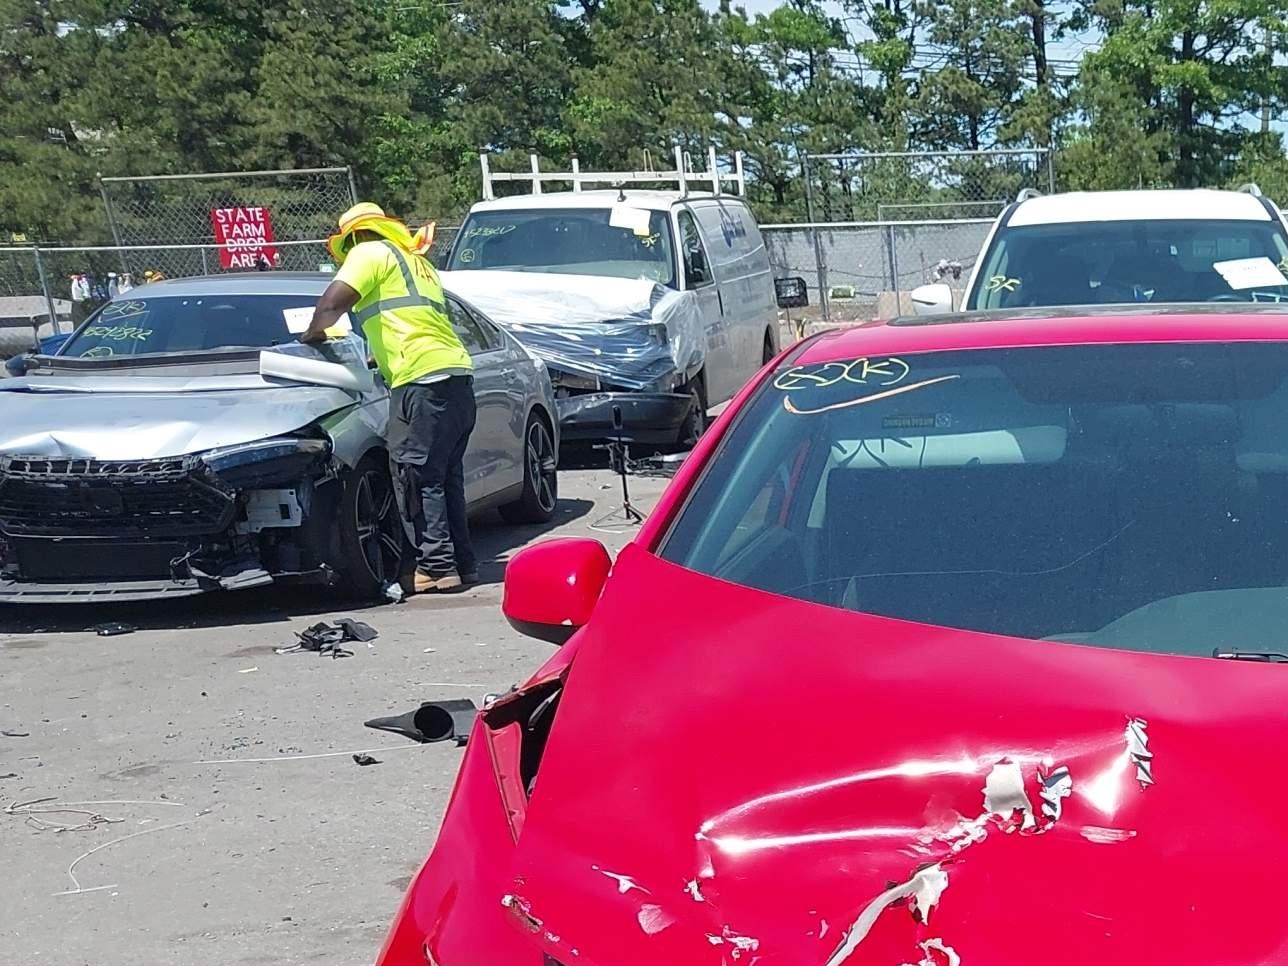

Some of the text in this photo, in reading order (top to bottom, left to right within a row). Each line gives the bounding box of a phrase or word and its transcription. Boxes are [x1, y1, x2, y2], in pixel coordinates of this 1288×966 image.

[215, 207, 265, 223] STATE
[221, 223, 266, 238] FARM
[225, 237, 267, 252] DROP
[230, 252, 271, 268] AREA
